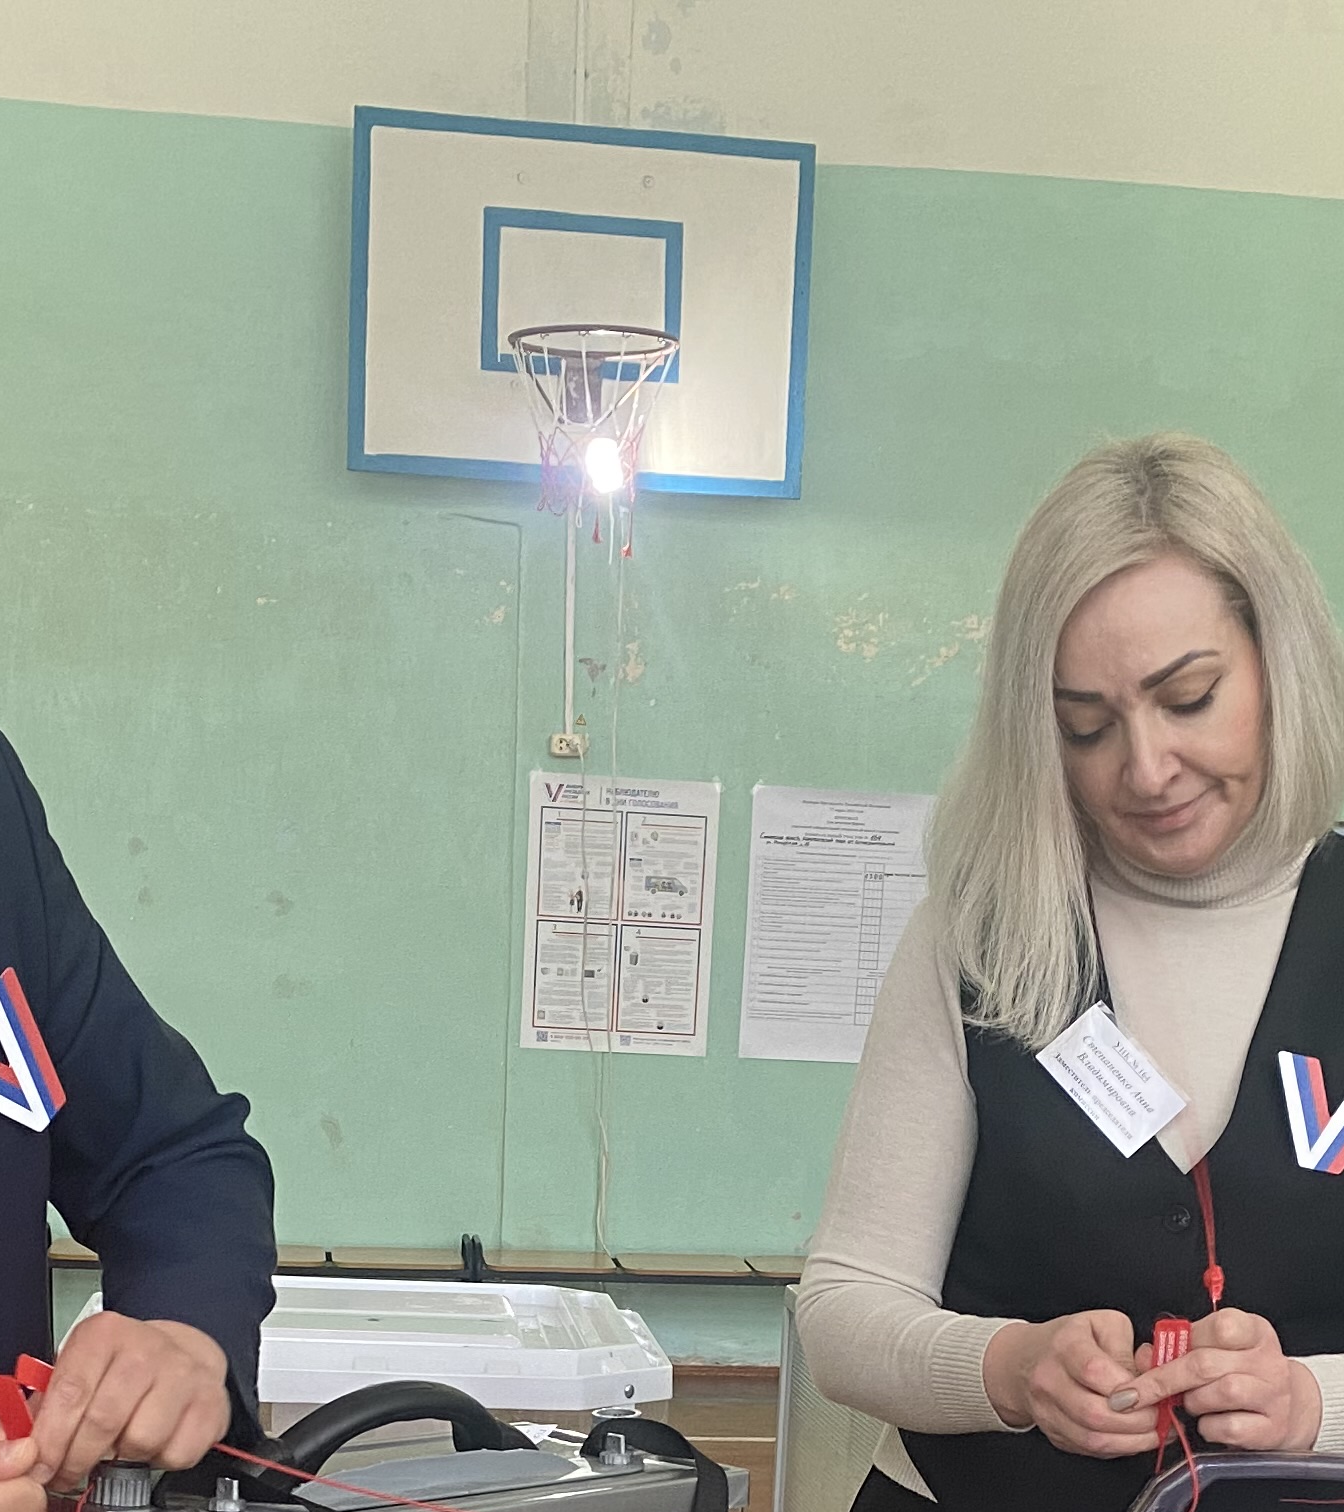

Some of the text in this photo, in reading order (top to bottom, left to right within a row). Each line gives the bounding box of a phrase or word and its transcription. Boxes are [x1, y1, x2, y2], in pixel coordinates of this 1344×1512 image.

[1077, 1051, 1137, 1117] Владимировна
[1082, 1035, 1155, 1114] Степаненко Анна
